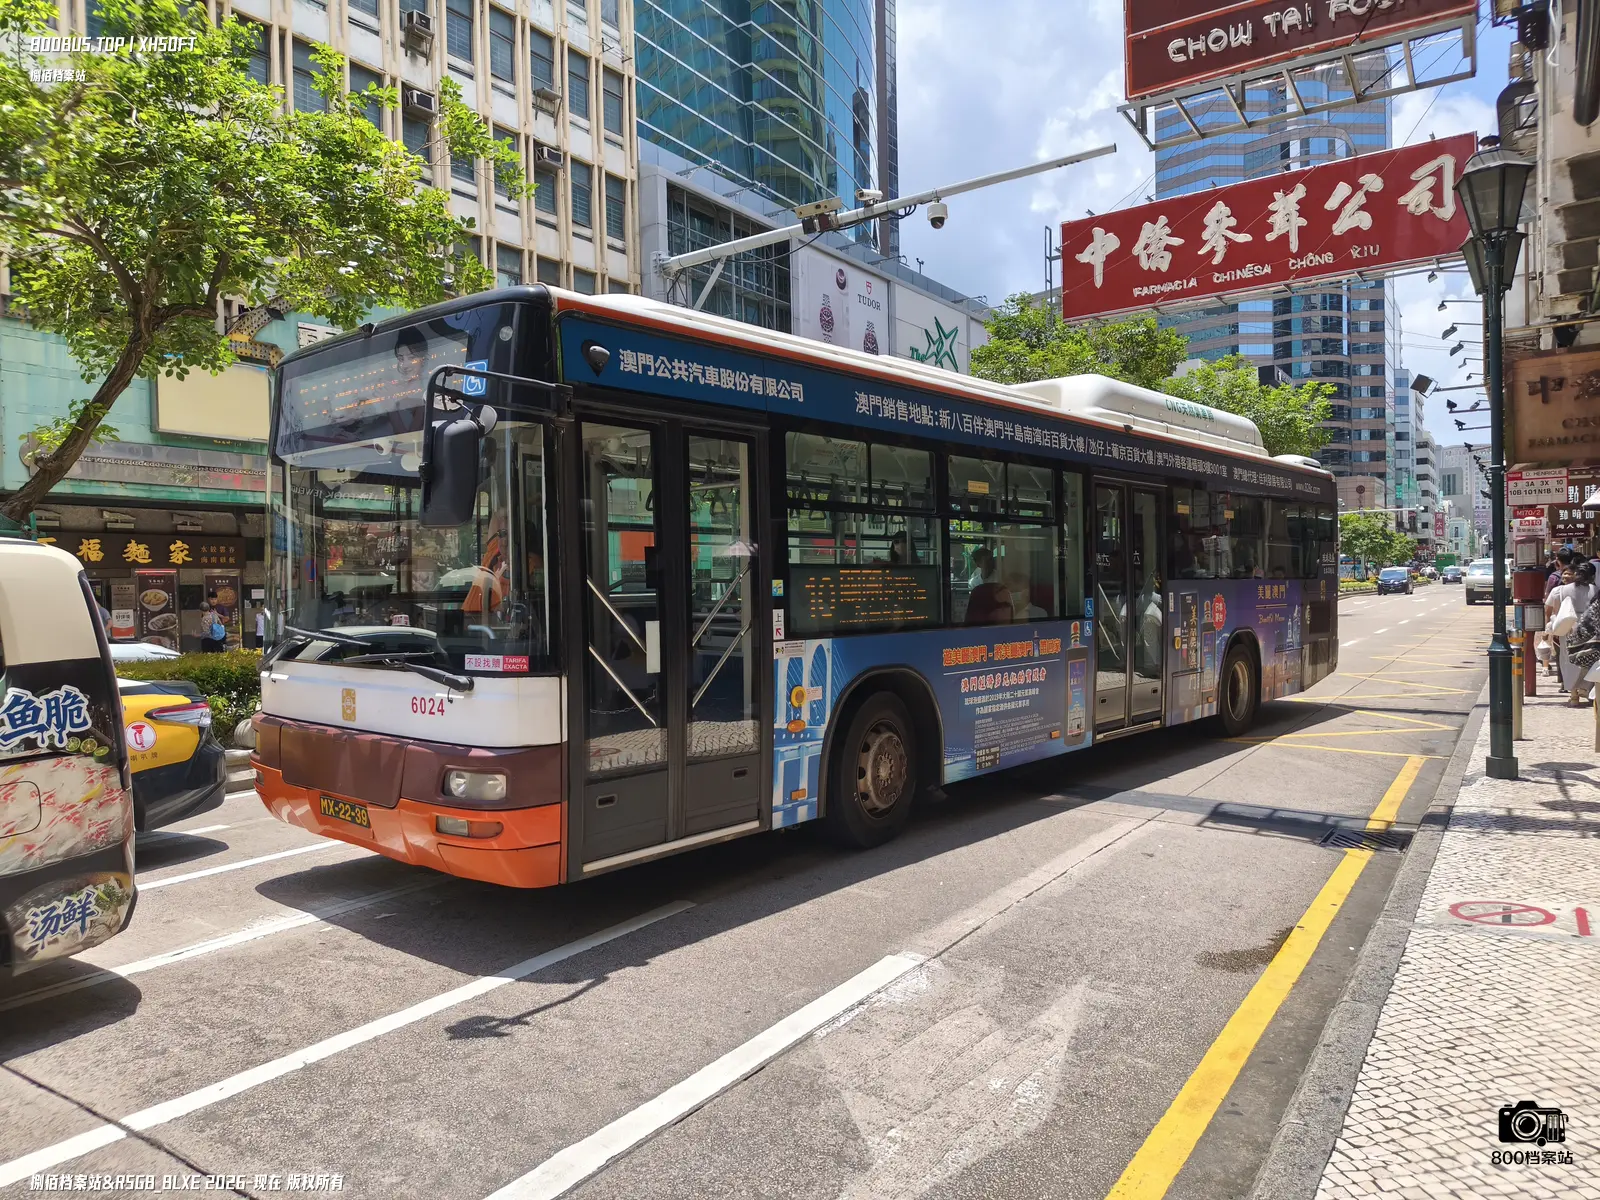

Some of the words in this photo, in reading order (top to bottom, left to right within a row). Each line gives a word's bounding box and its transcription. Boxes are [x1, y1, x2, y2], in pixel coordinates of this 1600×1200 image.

[1167, 20, 1252, 63] CHOW
[1263, 3, 1312, 37] TAI
[857, 293, 881, 311] TUDOR
[1132, 277, 1199, 298] FARMACIA
[619, 348, 804, 402] 澳門公共汽車股份有限公司
[1533, 469, 1563, 477] HENRIQUE
[37, 537, 193, 565] 福麵家
[0, 688, 91, 747] 鱼脆
[411, 696, 446, 716] 6024
[319, 795, 369, 826] MX-22-39
[28, 890, 99, 949] 汤鲜
